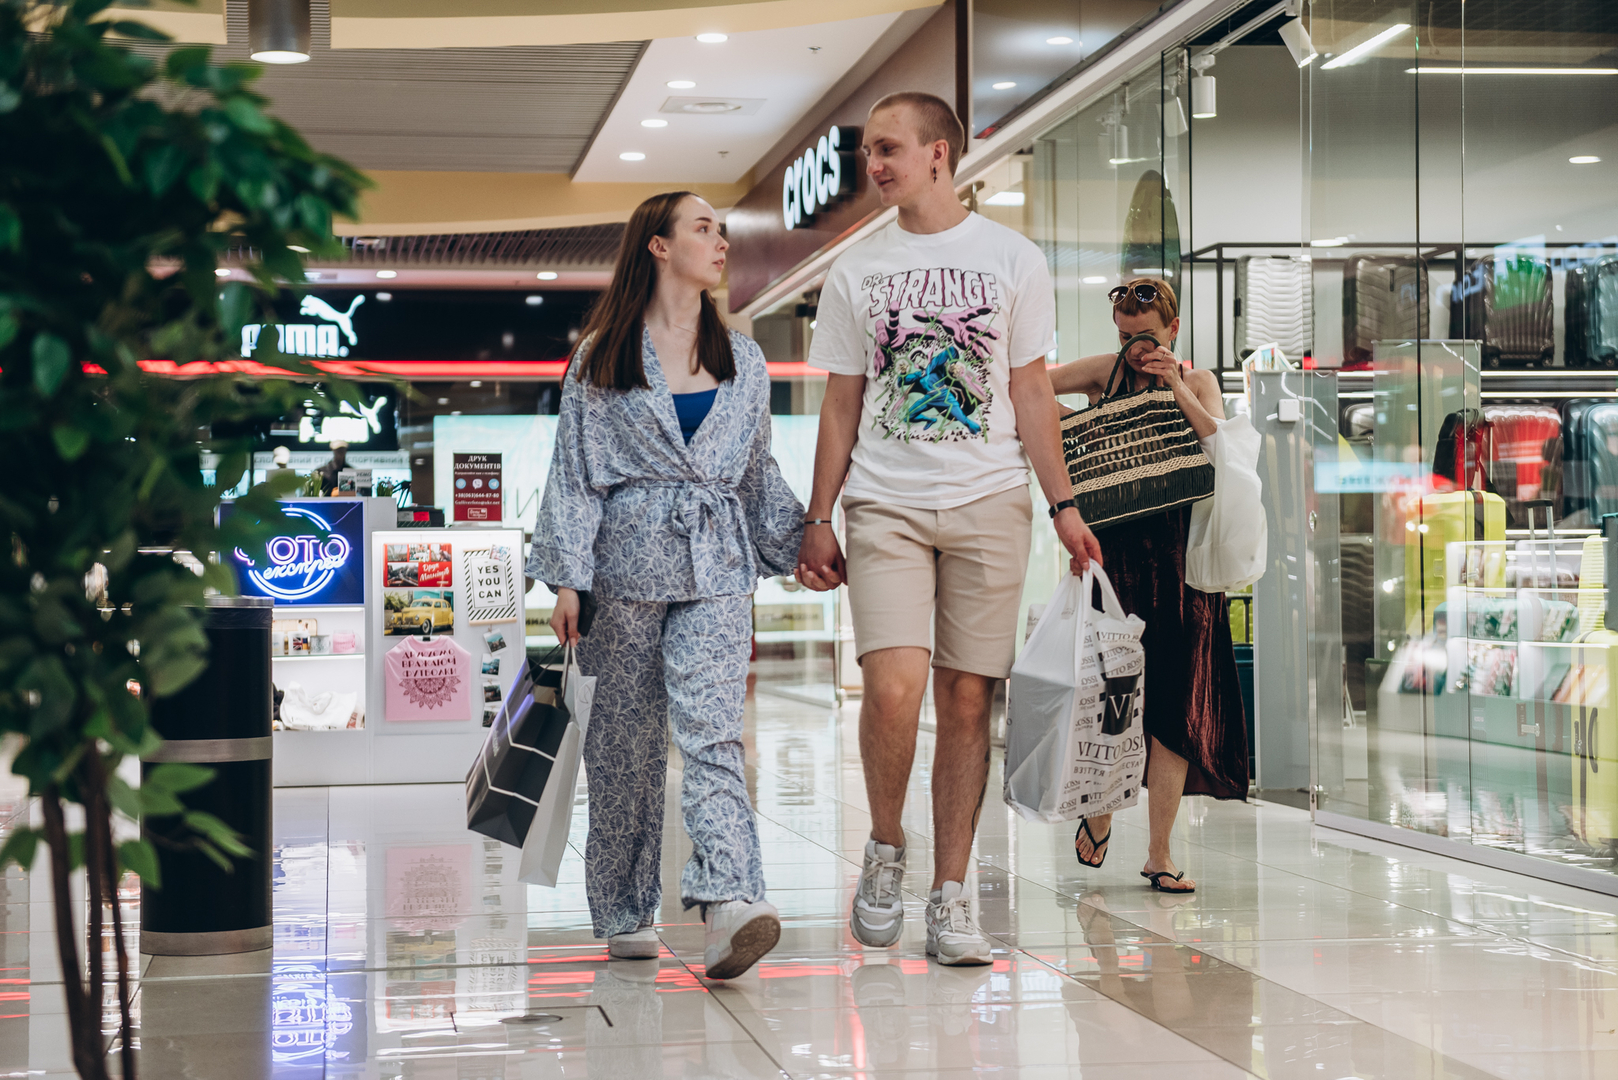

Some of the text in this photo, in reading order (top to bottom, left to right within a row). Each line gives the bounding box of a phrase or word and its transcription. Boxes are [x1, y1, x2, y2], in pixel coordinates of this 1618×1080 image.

[783, 125, 840, 231] crocs
[869, 267, 999, 318] STRANGE
[234, 534, 350, 566] ОТО
[477, 565, 499, 574] YES
[478, 577, 501, 586] YOU
[478, 590, 502, 598] CAN
